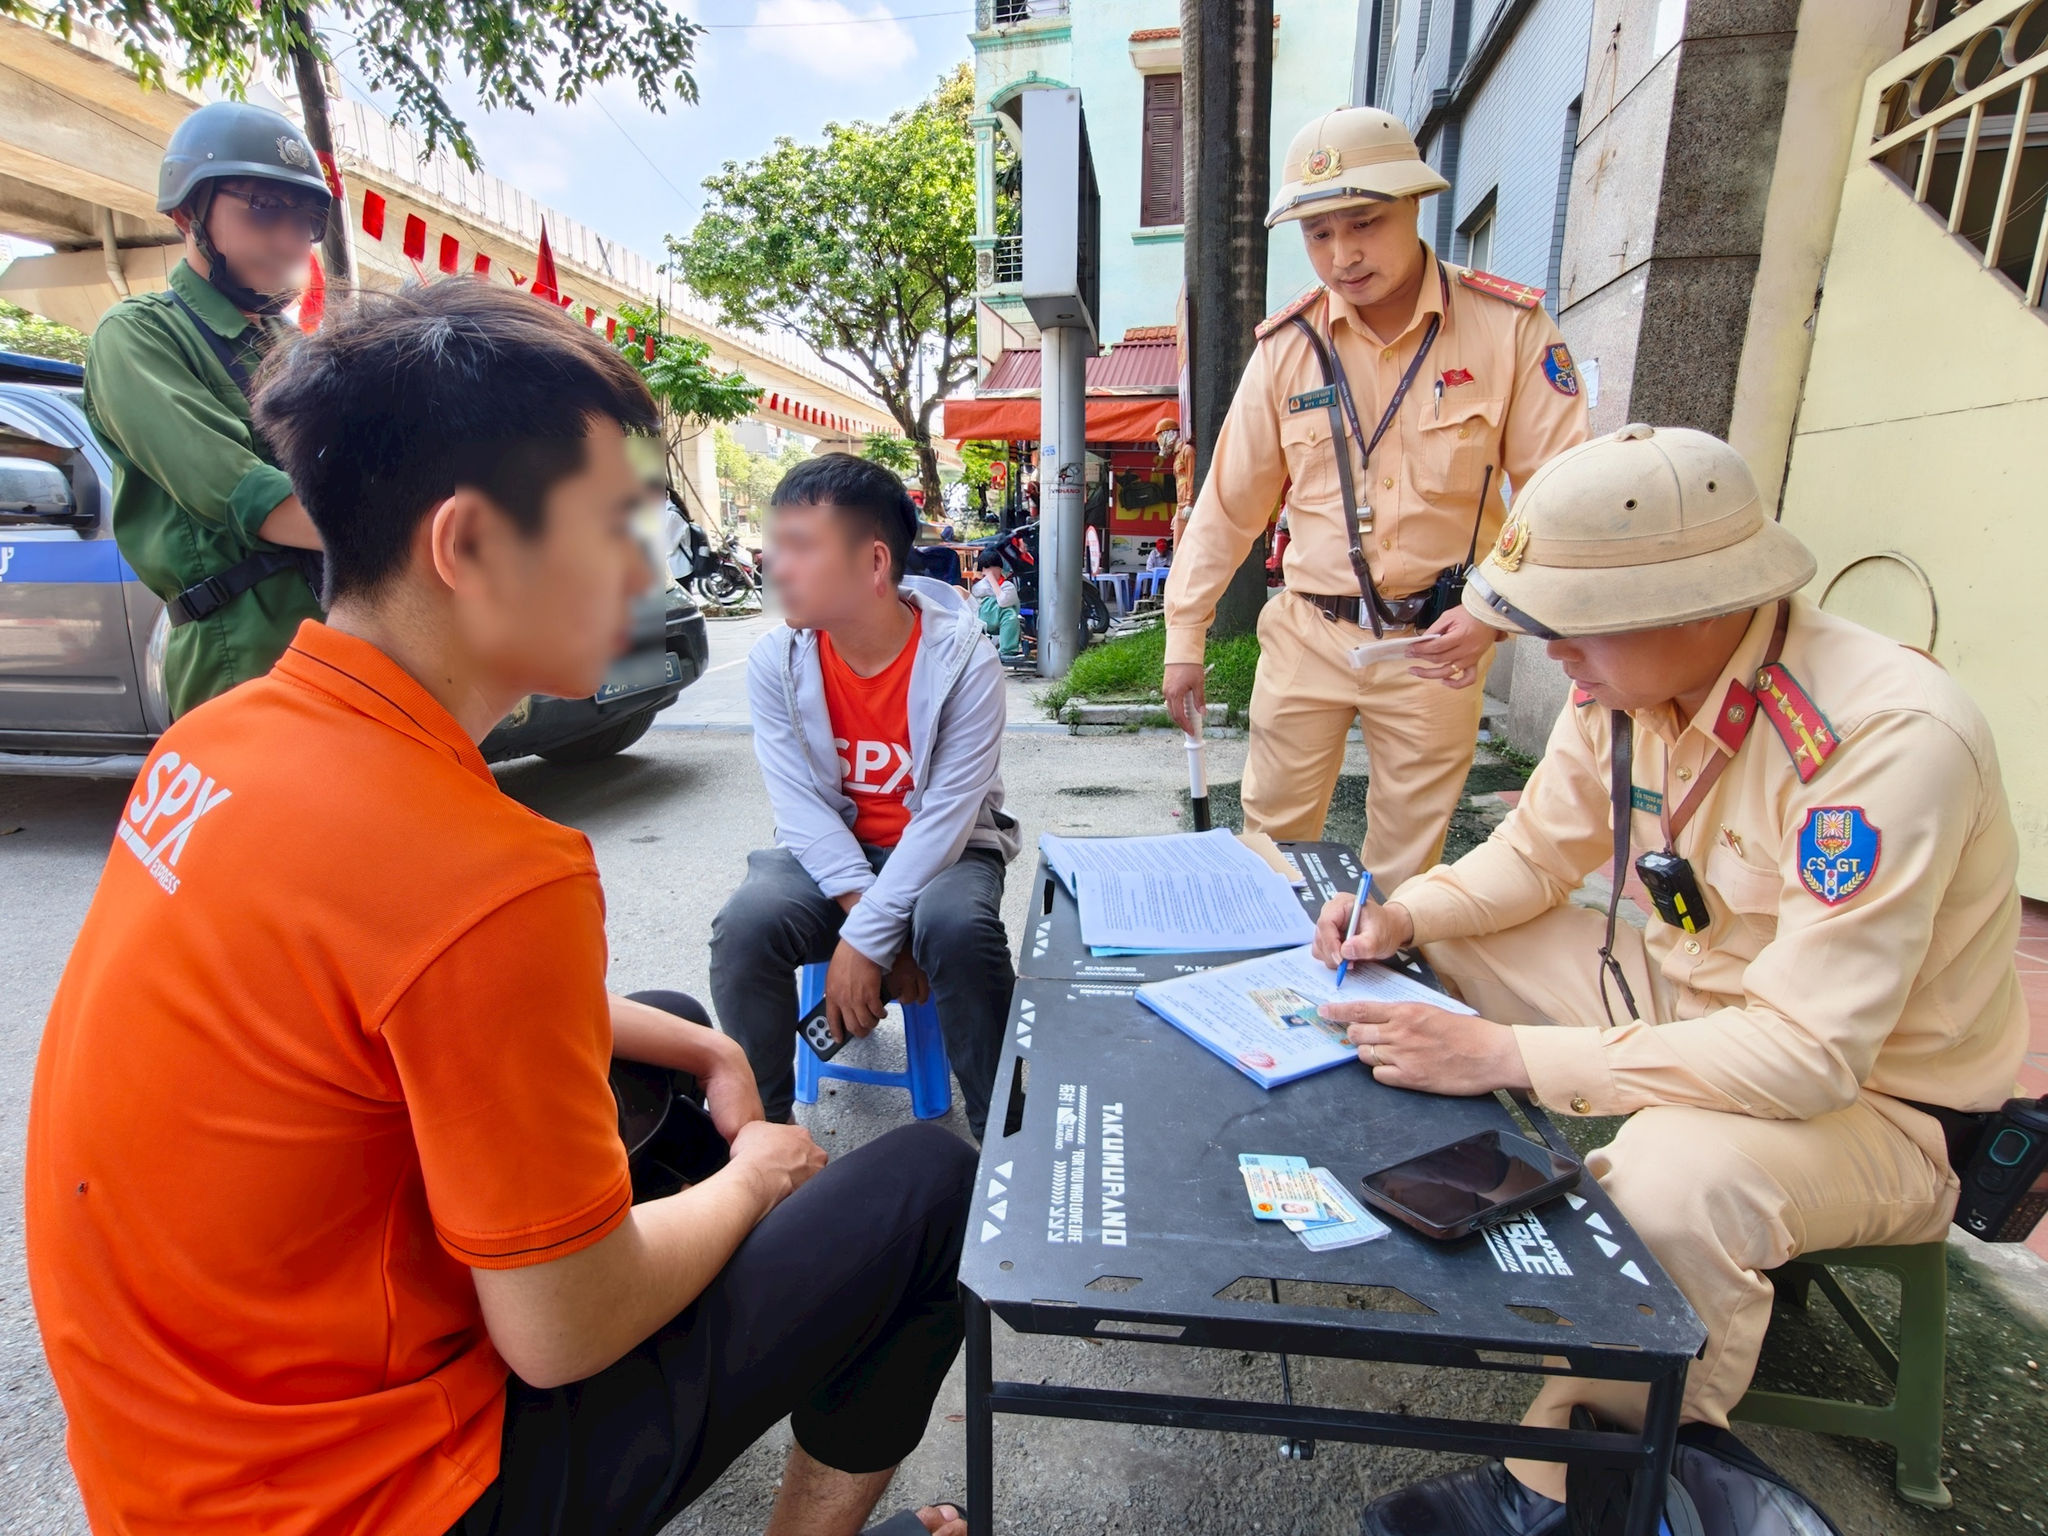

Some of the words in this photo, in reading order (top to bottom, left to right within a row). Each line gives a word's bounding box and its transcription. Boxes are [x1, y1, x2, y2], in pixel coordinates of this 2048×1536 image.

[130, 751, 233, 867] SPX
[149, 858, 182, 896] EXPRESS
[1070, 1165, 1085, 1183] YOU
[1101, 1102, 1127, 1247] TAKUMURANO
[1069, 1183, 1084, 1203] WHO
[1068, 1203, 1083, 1225] LOVE
[1067, 1224, 1083, 1244] LIFE
[1500, 1218, 1556, 1275] BLE
